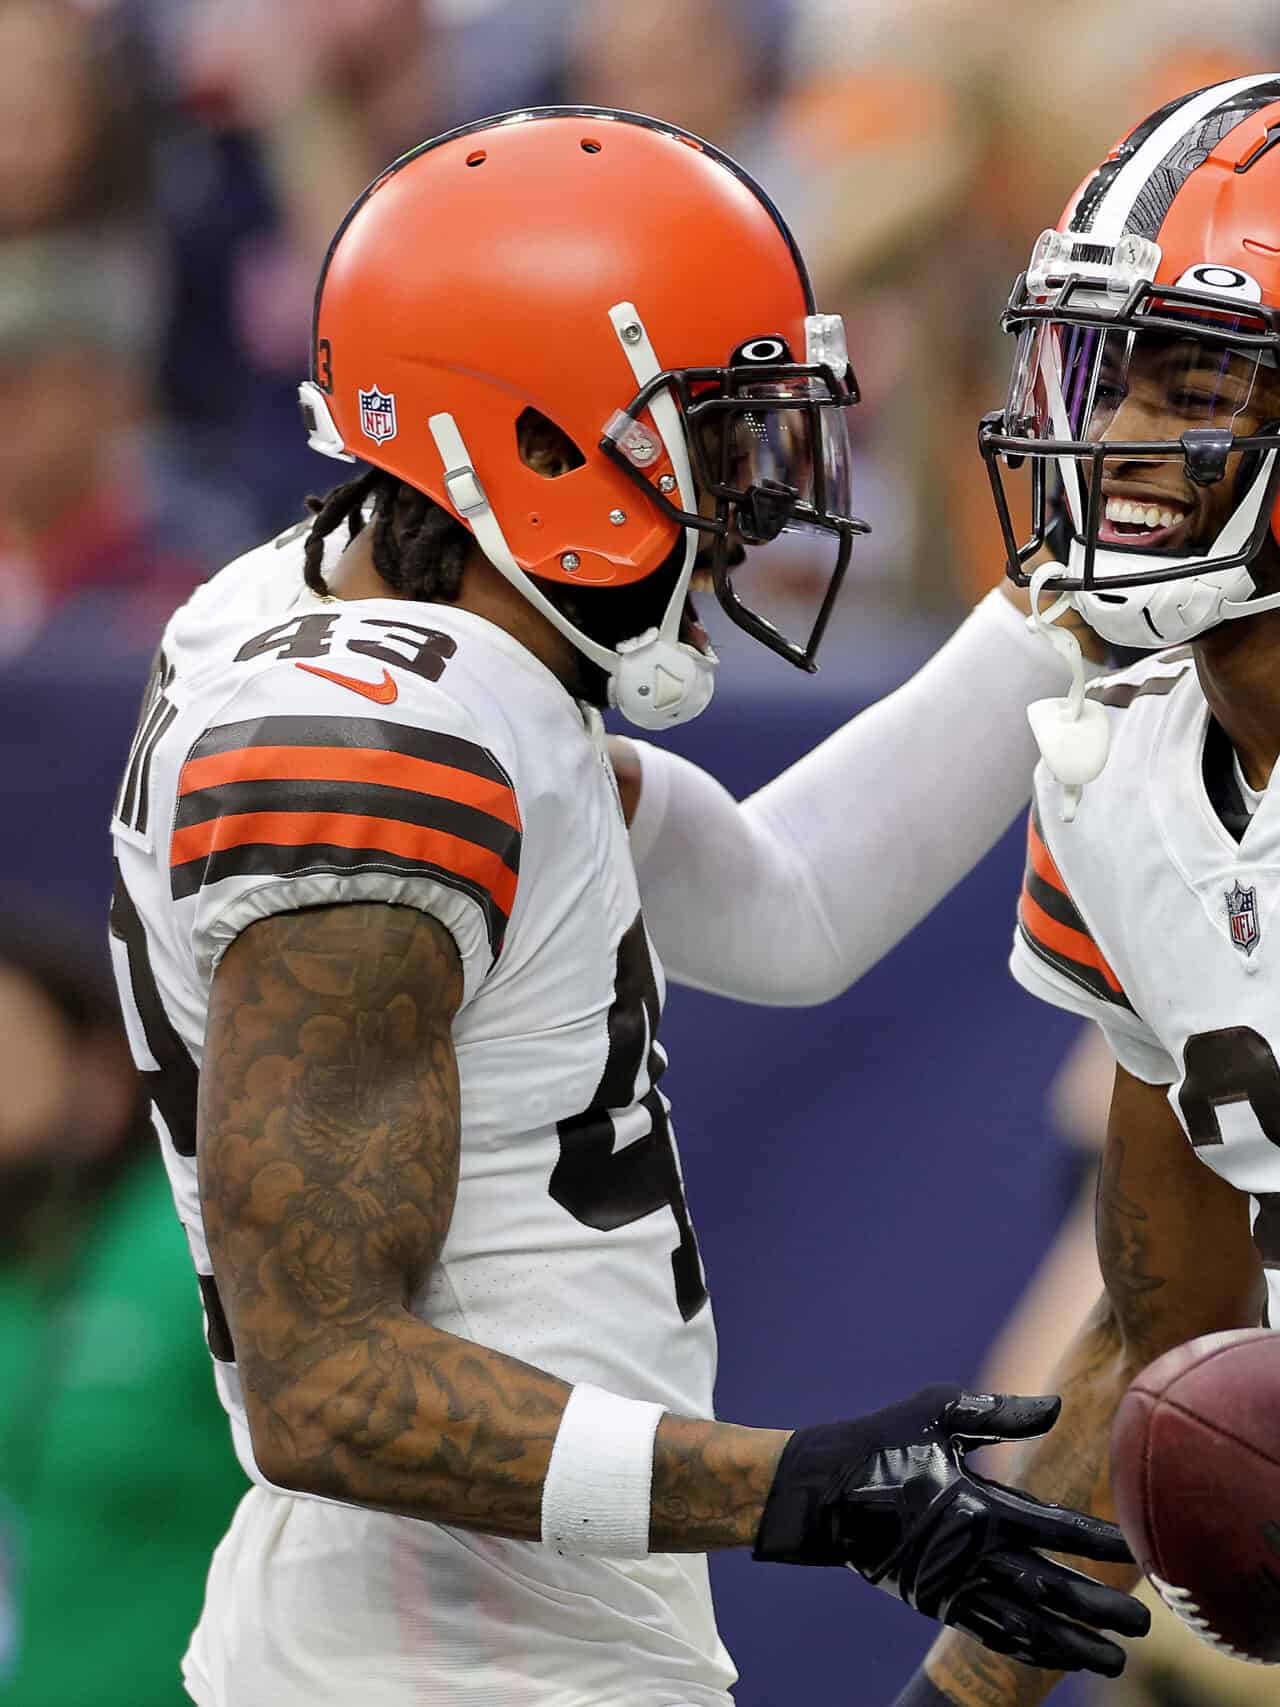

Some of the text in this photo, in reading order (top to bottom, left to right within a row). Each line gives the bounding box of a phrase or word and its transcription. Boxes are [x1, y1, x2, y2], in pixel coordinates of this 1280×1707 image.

[364, 411, 392, 435] NFL
[233, 614, 458, 682] 43
[1232, 913, 1254, 942] NFL
